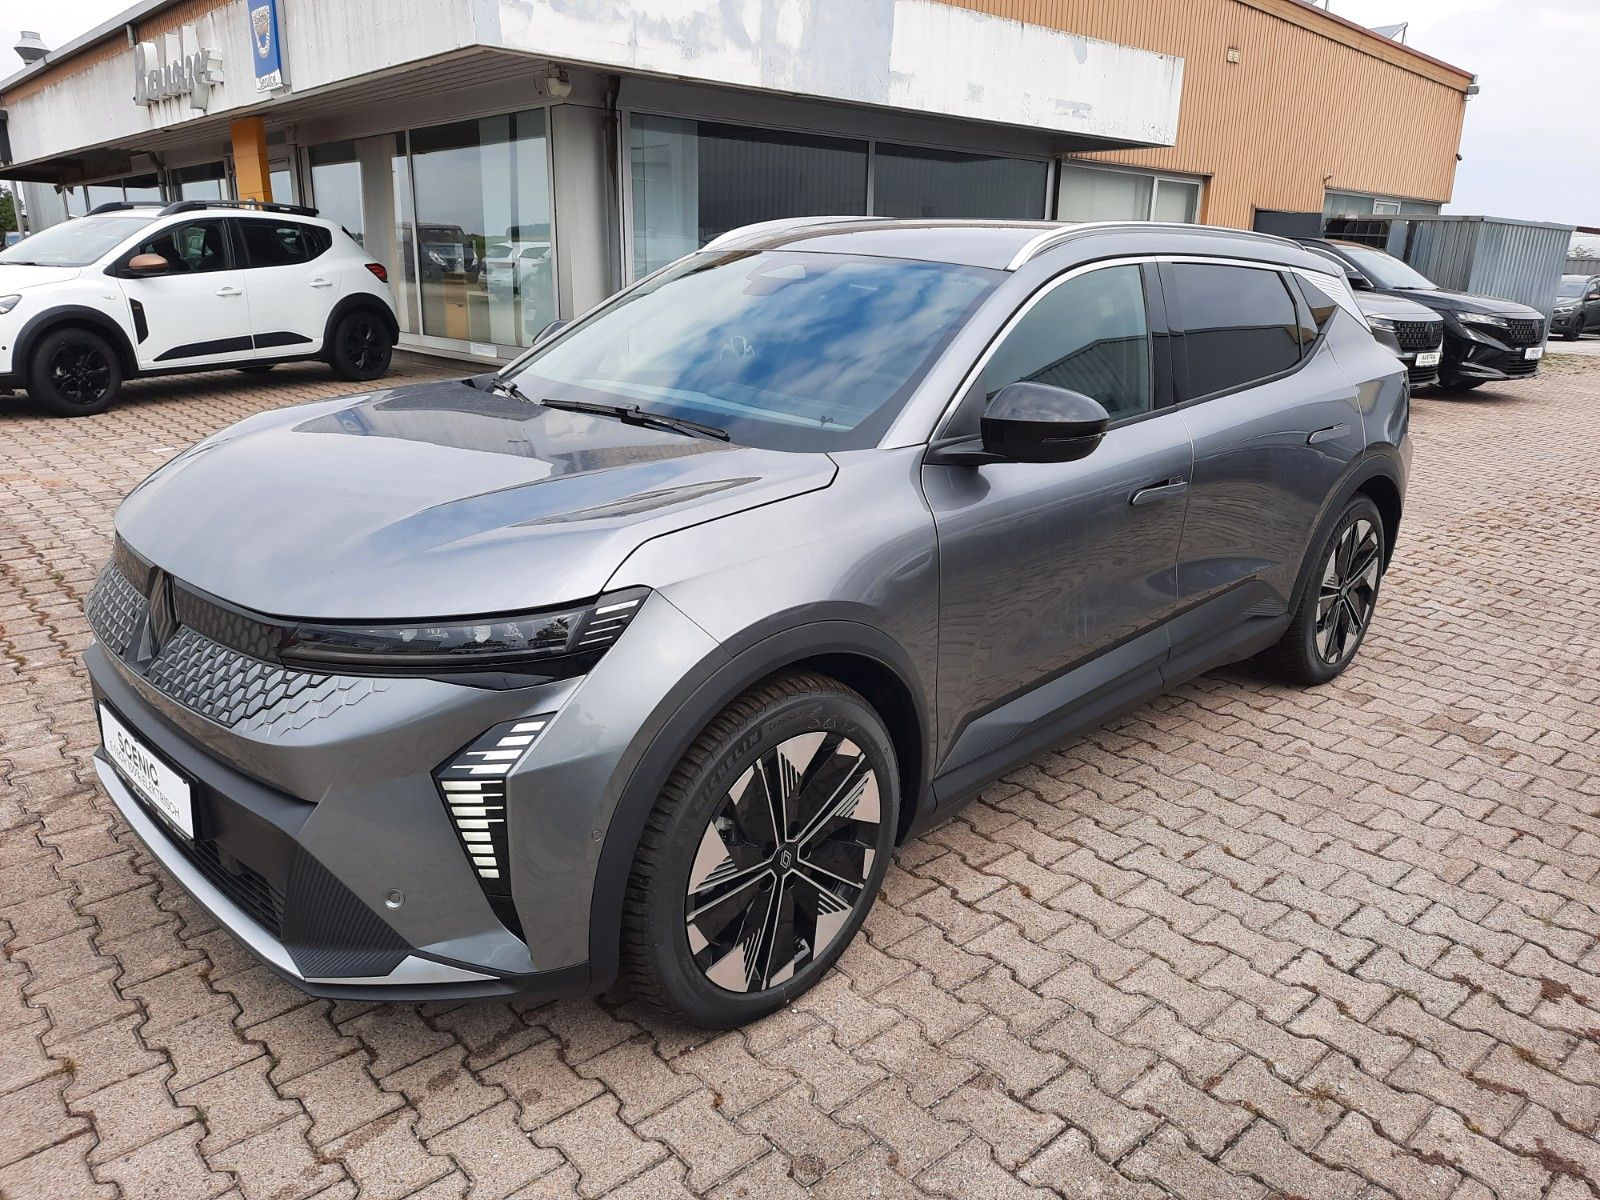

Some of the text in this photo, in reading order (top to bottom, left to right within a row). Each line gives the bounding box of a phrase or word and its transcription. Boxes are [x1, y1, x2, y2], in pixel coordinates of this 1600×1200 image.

[117, 731, 158, 786] SCENIC
[694, 731, 760, 811] MICHELIN
[142, 773, 180, 818] ELEKTRISCH
